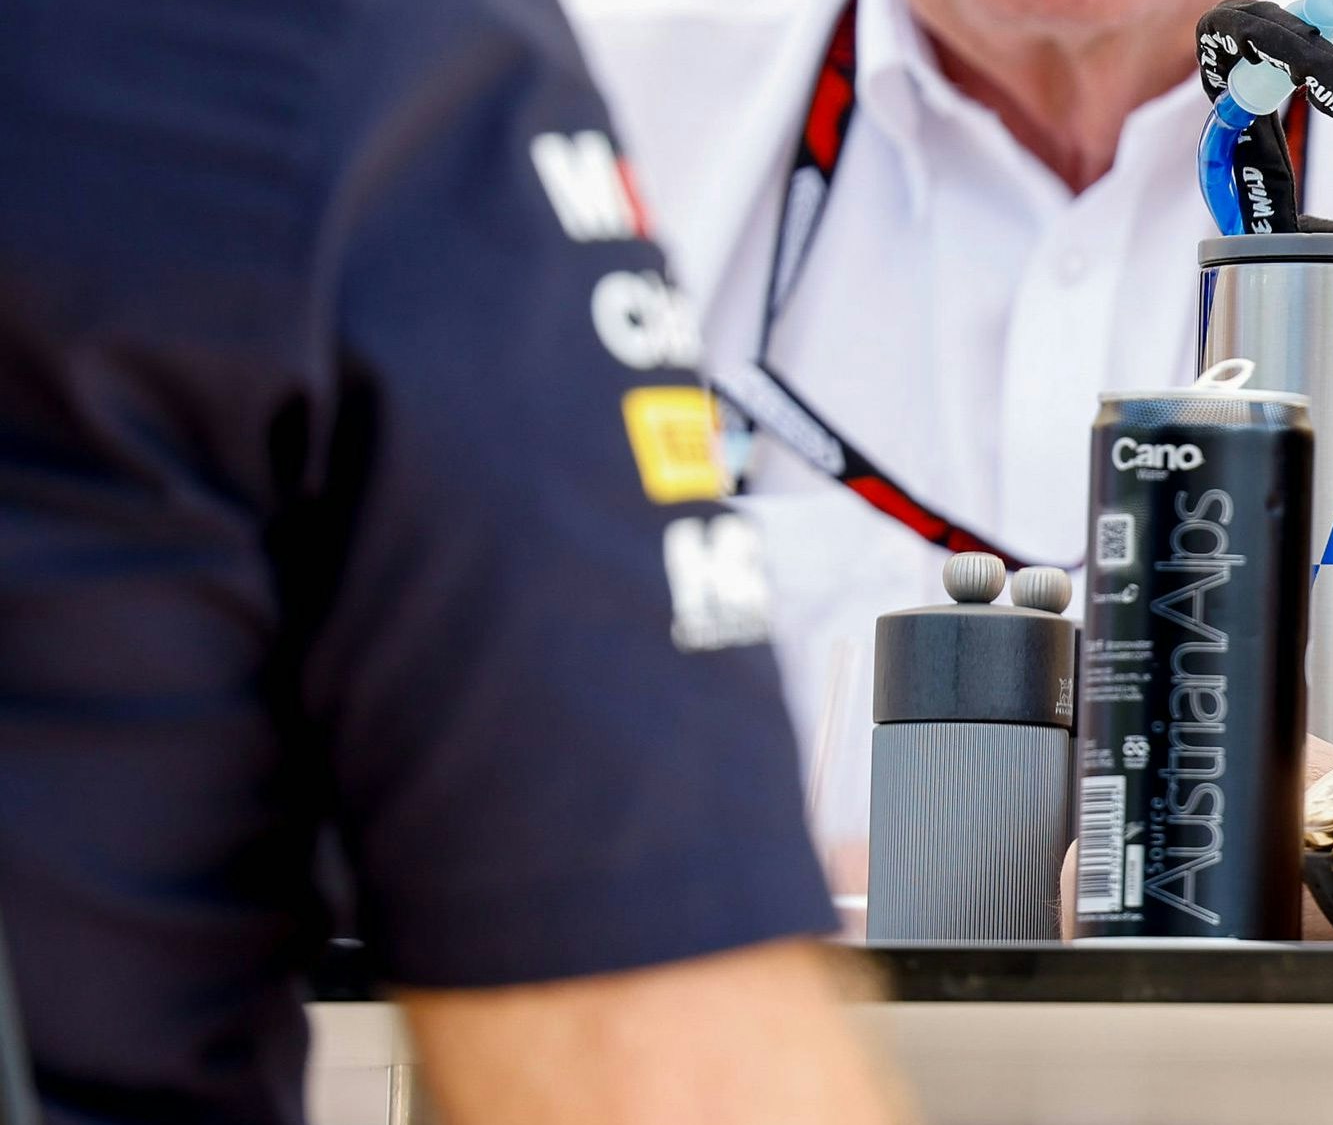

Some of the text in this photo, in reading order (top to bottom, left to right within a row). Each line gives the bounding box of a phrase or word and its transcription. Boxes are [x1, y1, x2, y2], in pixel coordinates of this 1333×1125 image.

[1242, 166, 1275, 218] WILD
[1111, 436, 1204, 472] Cano
[1147, 796, 1167, 874] Source
